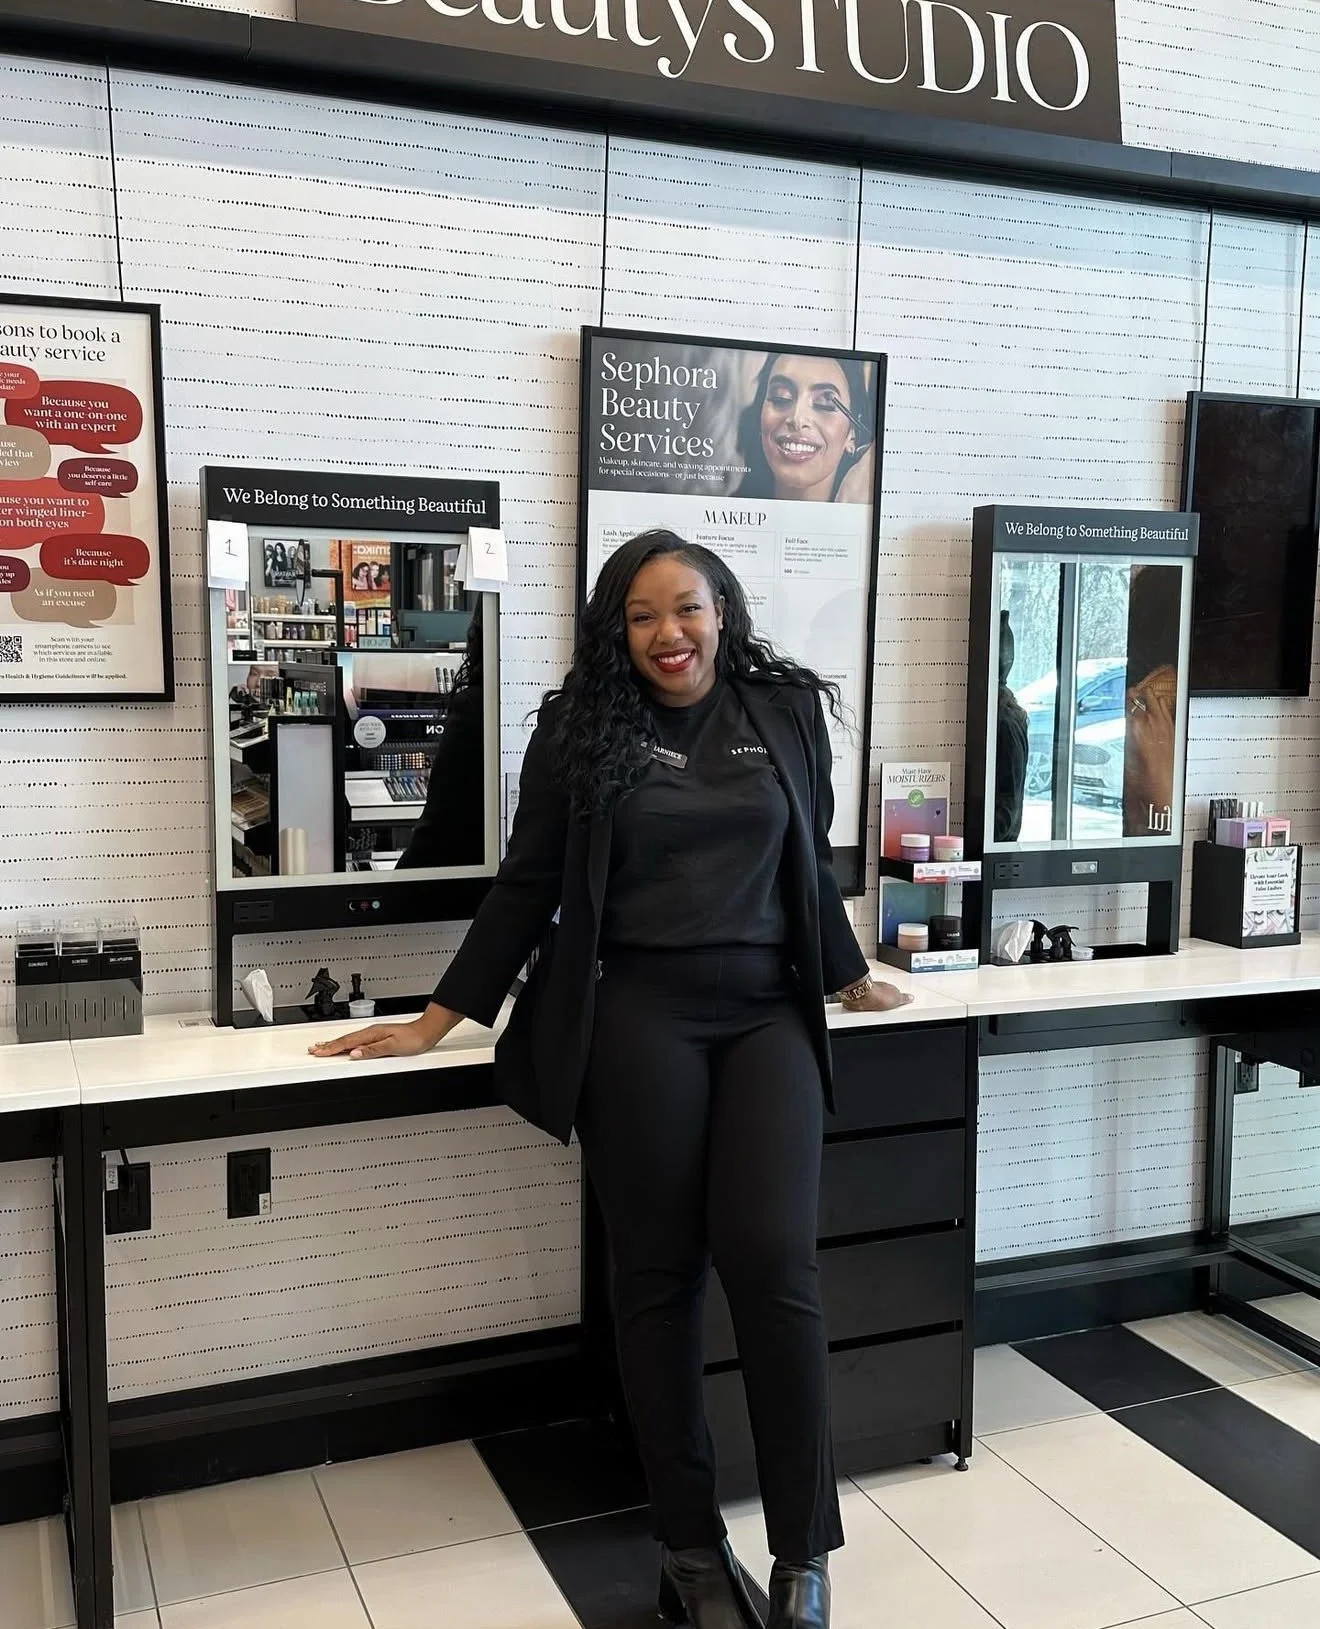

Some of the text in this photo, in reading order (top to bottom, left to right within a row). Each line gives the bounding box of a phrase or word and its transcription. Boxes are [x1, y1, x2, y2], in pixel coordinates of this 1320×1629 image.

[0, 324, 121, 343] ons to book a
[45, 346, 106, 362] service
[601, 351, 718, 391] Sephora
[42, 395, 109, 410] Because you
[601, 387, 701, 429] Beauty
[24, 408, 127, 421] want a one-on-one
[36, 419, 117, 432] with an expert
[600, 422, 714, 458] Services
[15, 449, 34, 458] that
[84, 465, 111, 473] Because
[599, 467, 609, 475] for
[610, 468, 635, 477] special
[698, 473, 725, 481] because
[704, 464, 752, 473] appointments
[23, 497, 44, 507] you
[46, 498, 74, 506] want
[77, 498, 89, 507] to
[223, 487, 486, 515] We Belong to Something Beautiful
[15, 506, 57, 518] winged
[703, 509, 768, 527] MAKEUP
[16, 517, 43, 528] both
[45, 521, 69, 531] eyes
[1005, 522, 1190, 542] We Belong to Something Beautiful
[75, 548, 112, 557] Because
[484, 542, 496, 554] 2
[78, 557, 98, 566] date
[99, 558, 124, 569] night
[34, 588, 95, 599] As if you need
[56, 599, 86, 607] excuse
[888, 773, 946, 784] MOISTURIZERS
